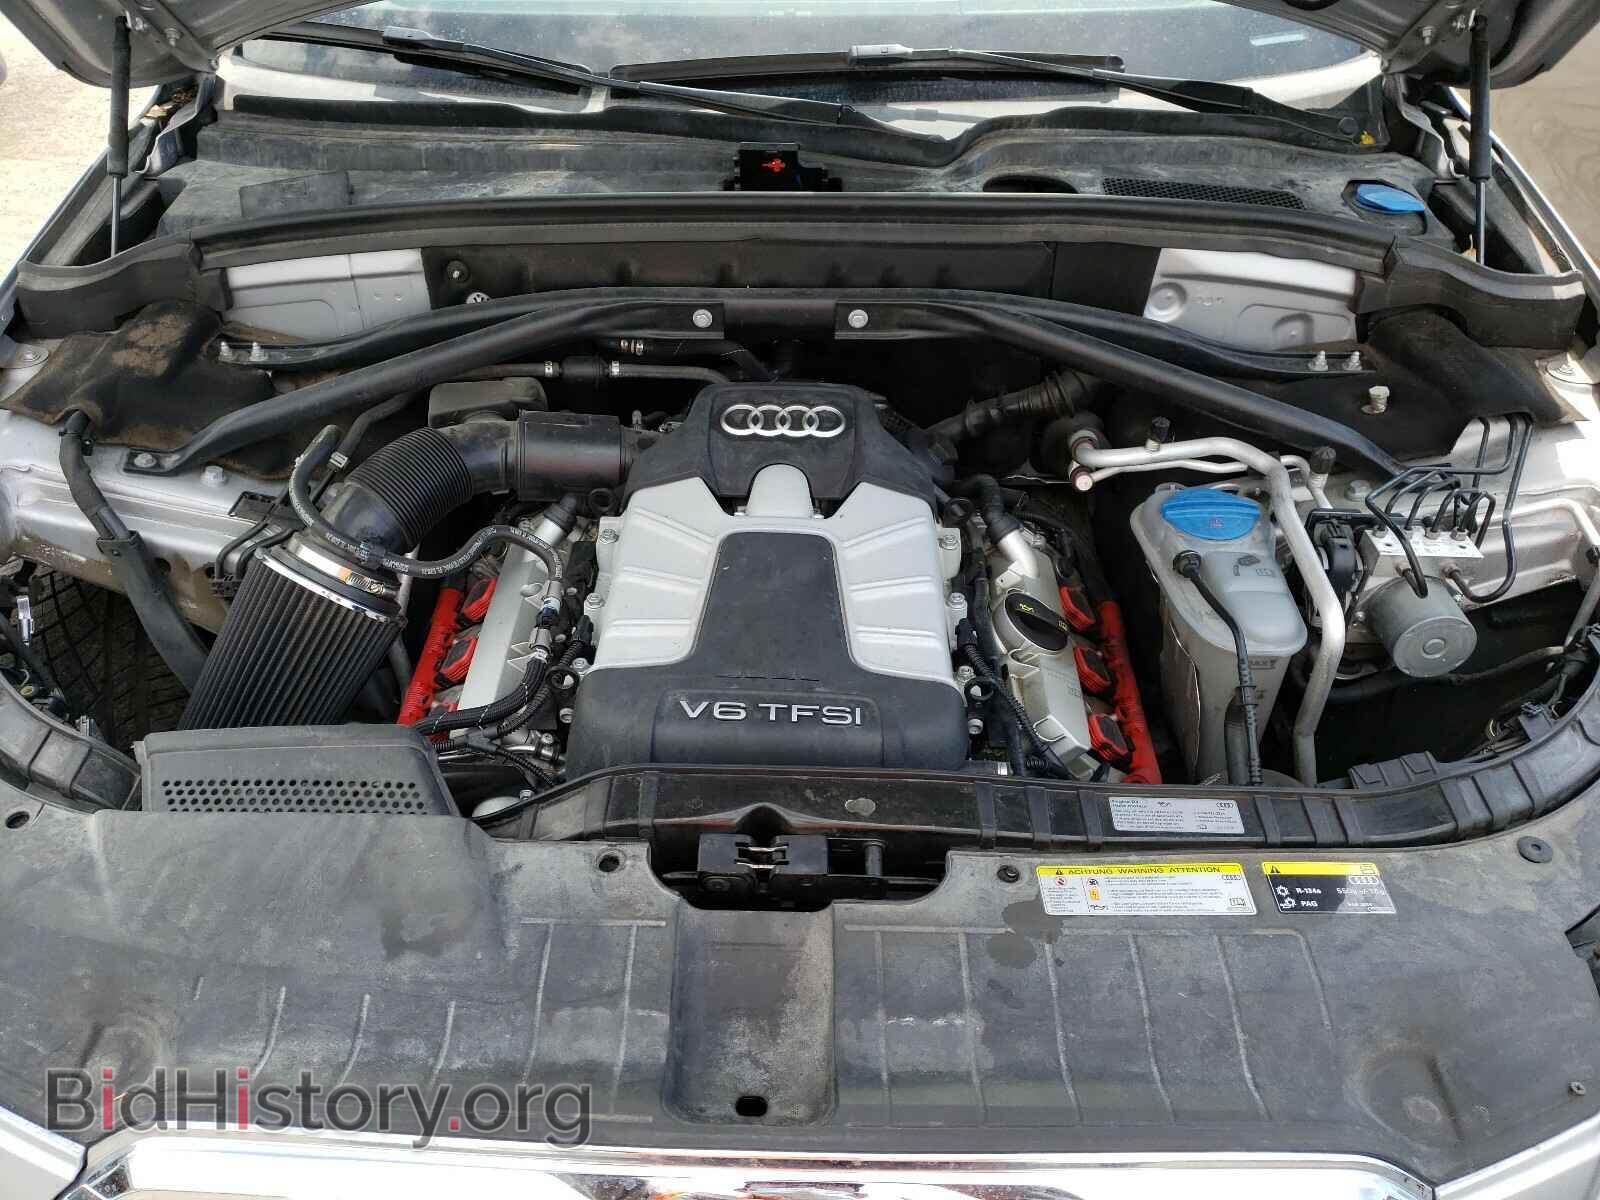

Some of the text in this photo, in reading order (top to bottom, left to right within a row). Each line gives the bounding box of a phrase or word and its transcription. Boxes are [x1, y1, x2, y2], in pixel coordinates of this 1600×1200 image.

[679, 700, 862, 725] V6 TFSI
[1068, 866, 1221, 876] ACHTUNG WARNING ATTENTION
[1300, 900, 1319, 908] PAG
